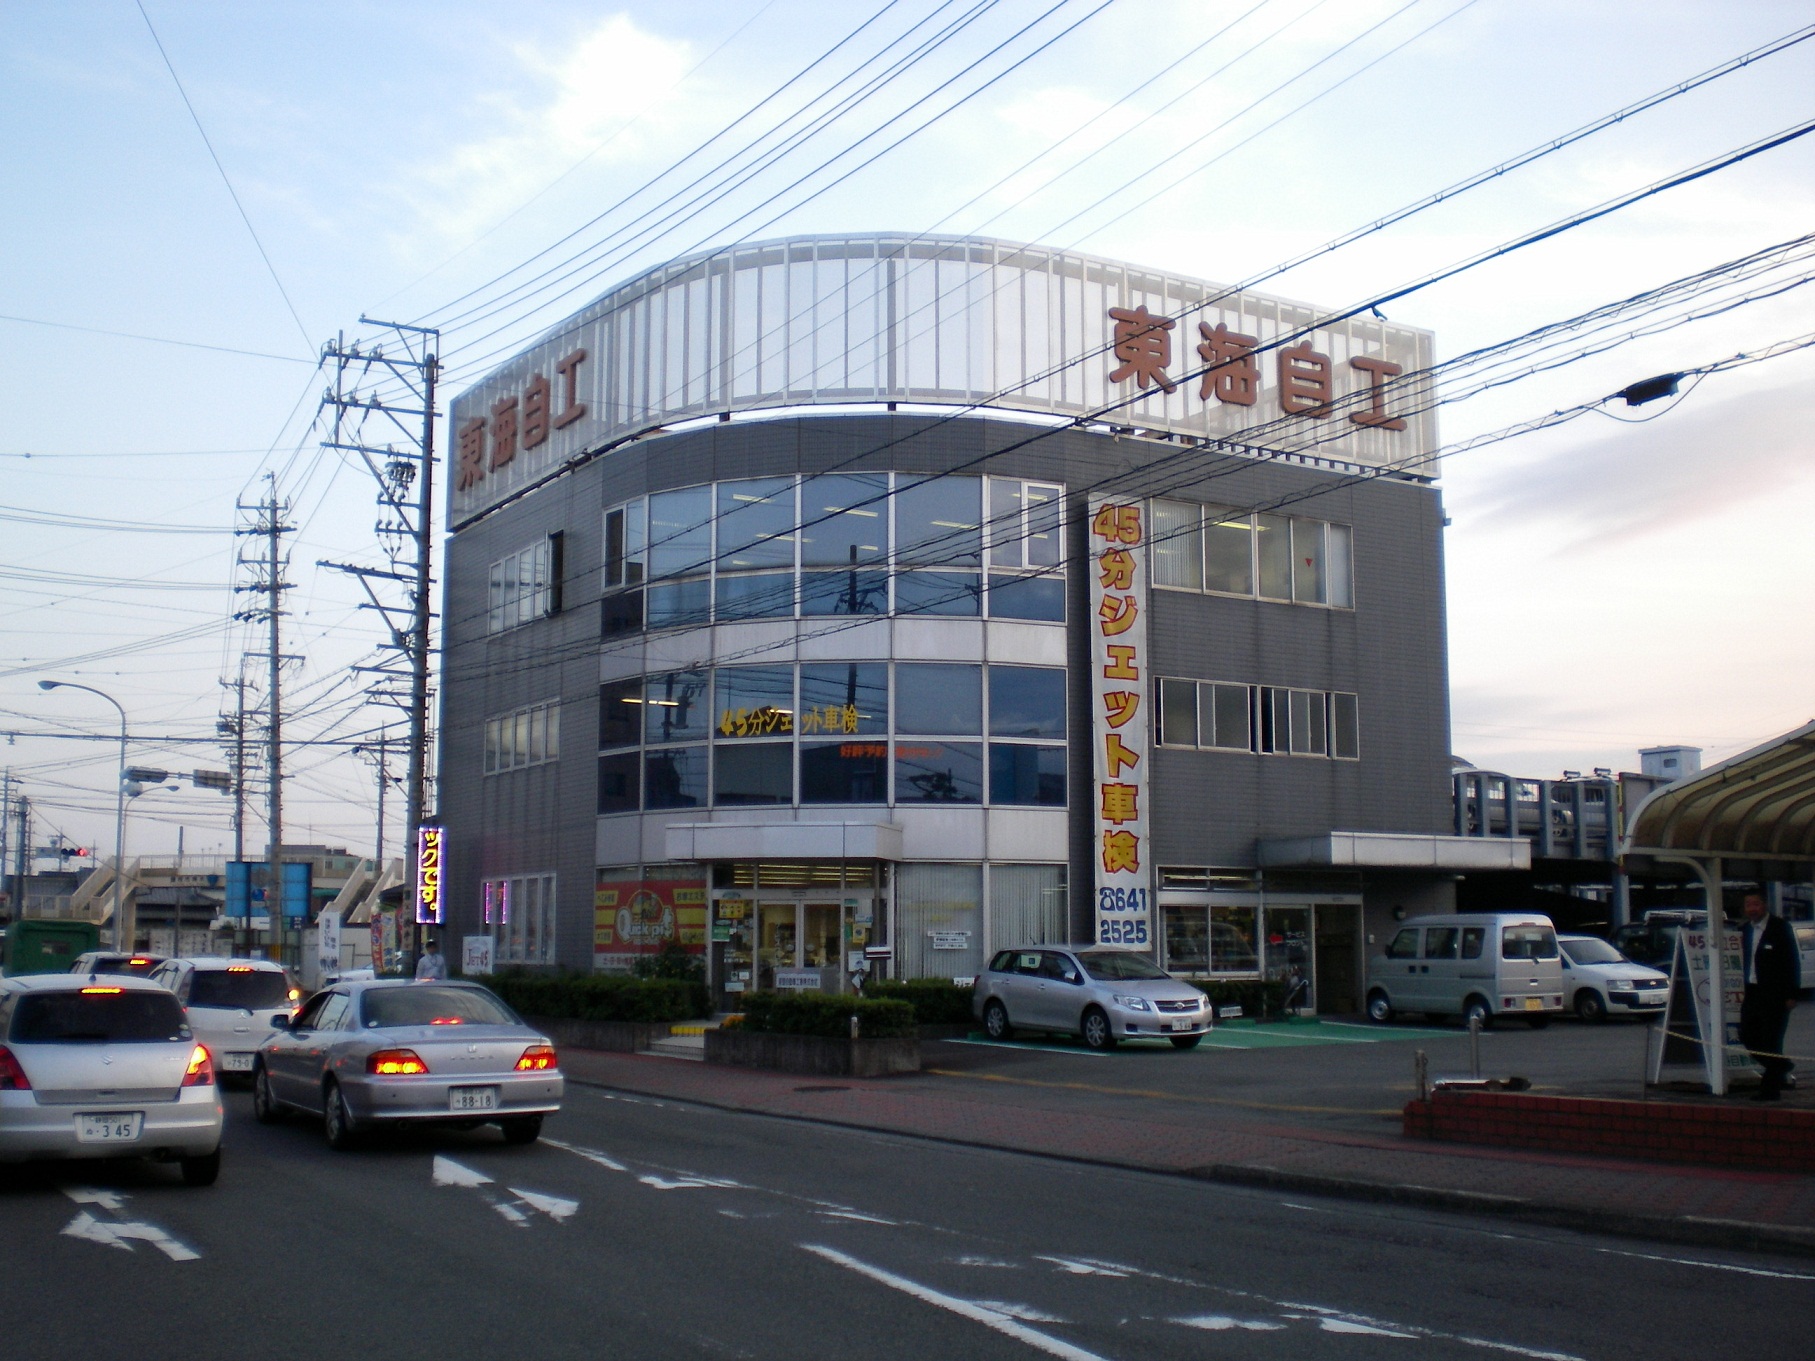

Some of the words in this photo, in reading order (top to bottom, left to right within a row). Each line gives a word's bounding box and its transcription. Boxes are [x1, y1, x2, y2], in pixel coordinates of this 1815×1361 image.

[1108, 304, 1408, 432] 東海自工
[457, 347, 587, 492] 東海自工
[1100, 919, 1148, 945] 2525
[1115, 888, 1147, 911] 641
